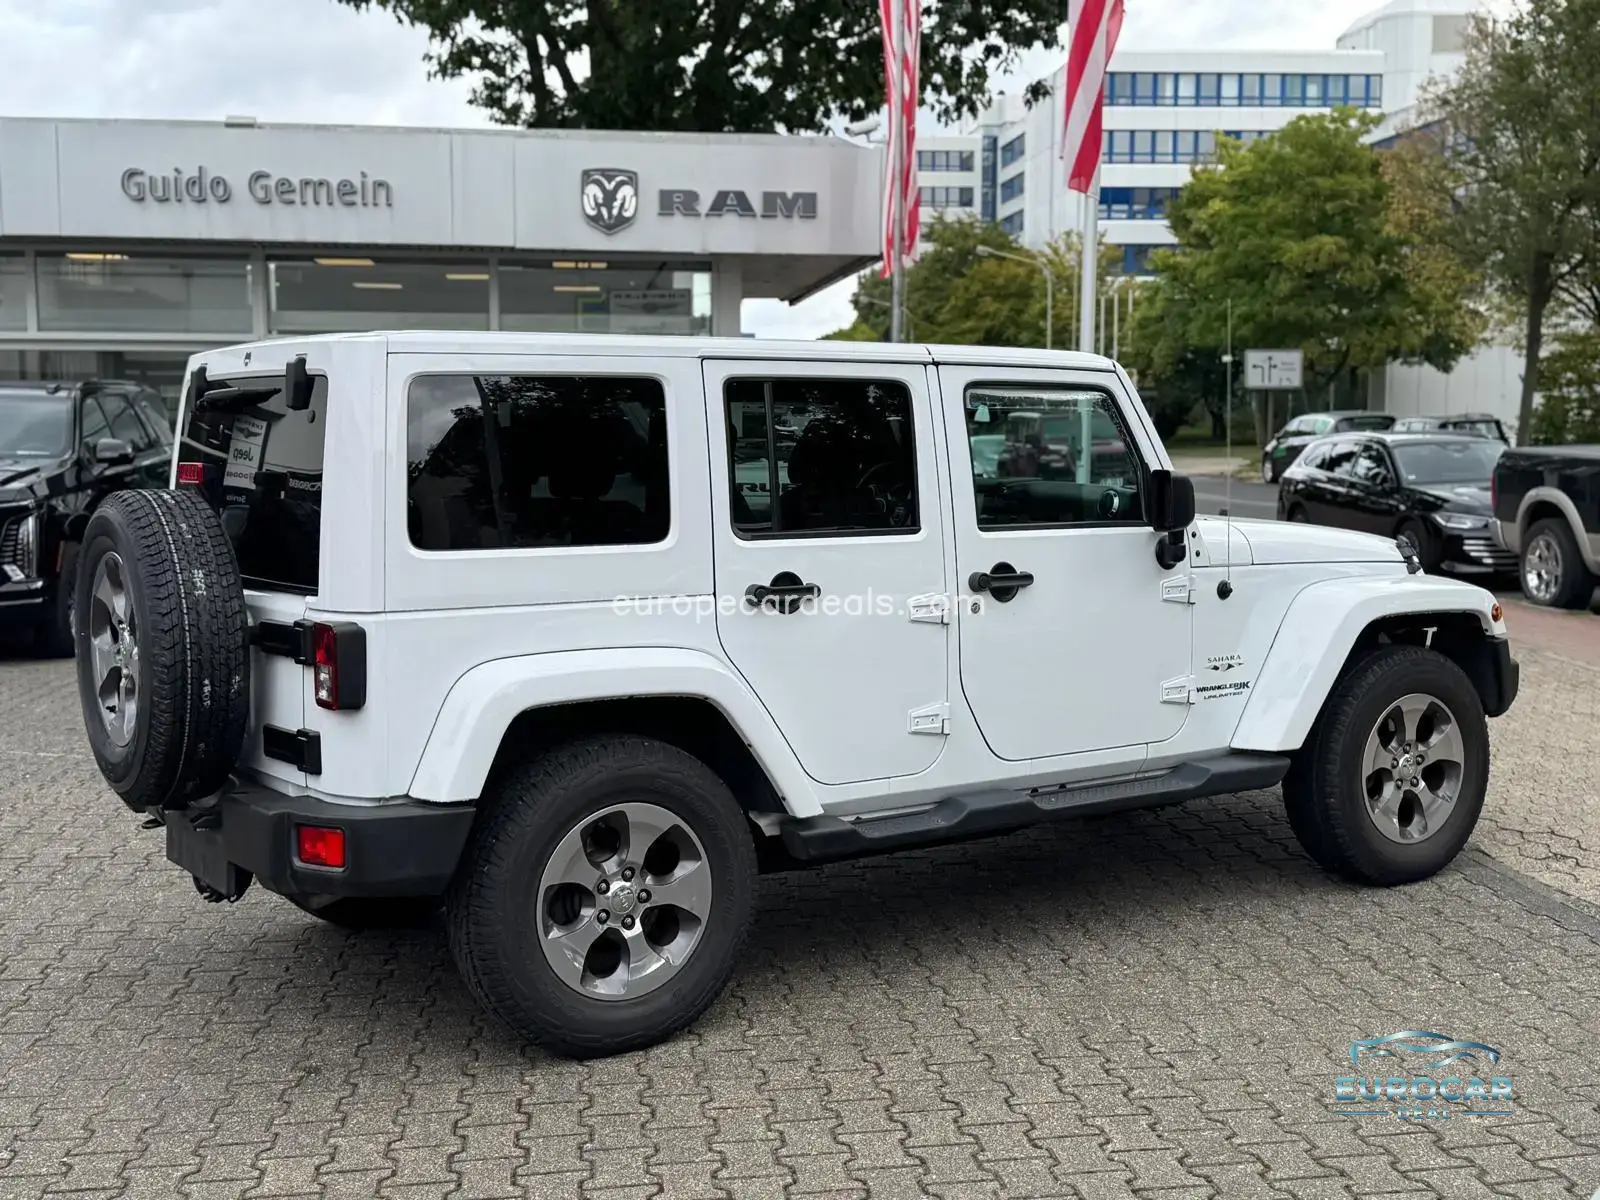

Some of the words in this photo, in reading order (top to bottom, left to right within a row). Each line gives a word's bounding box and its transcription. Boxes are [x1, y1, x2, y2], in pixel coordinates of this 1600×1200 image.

[121, 165, 231, 203] Guido
[248, 170, 393, 207] Gemein
[657, 188, 818, 219] RAM
[1207, 654, 1241, 663] SAHARA
